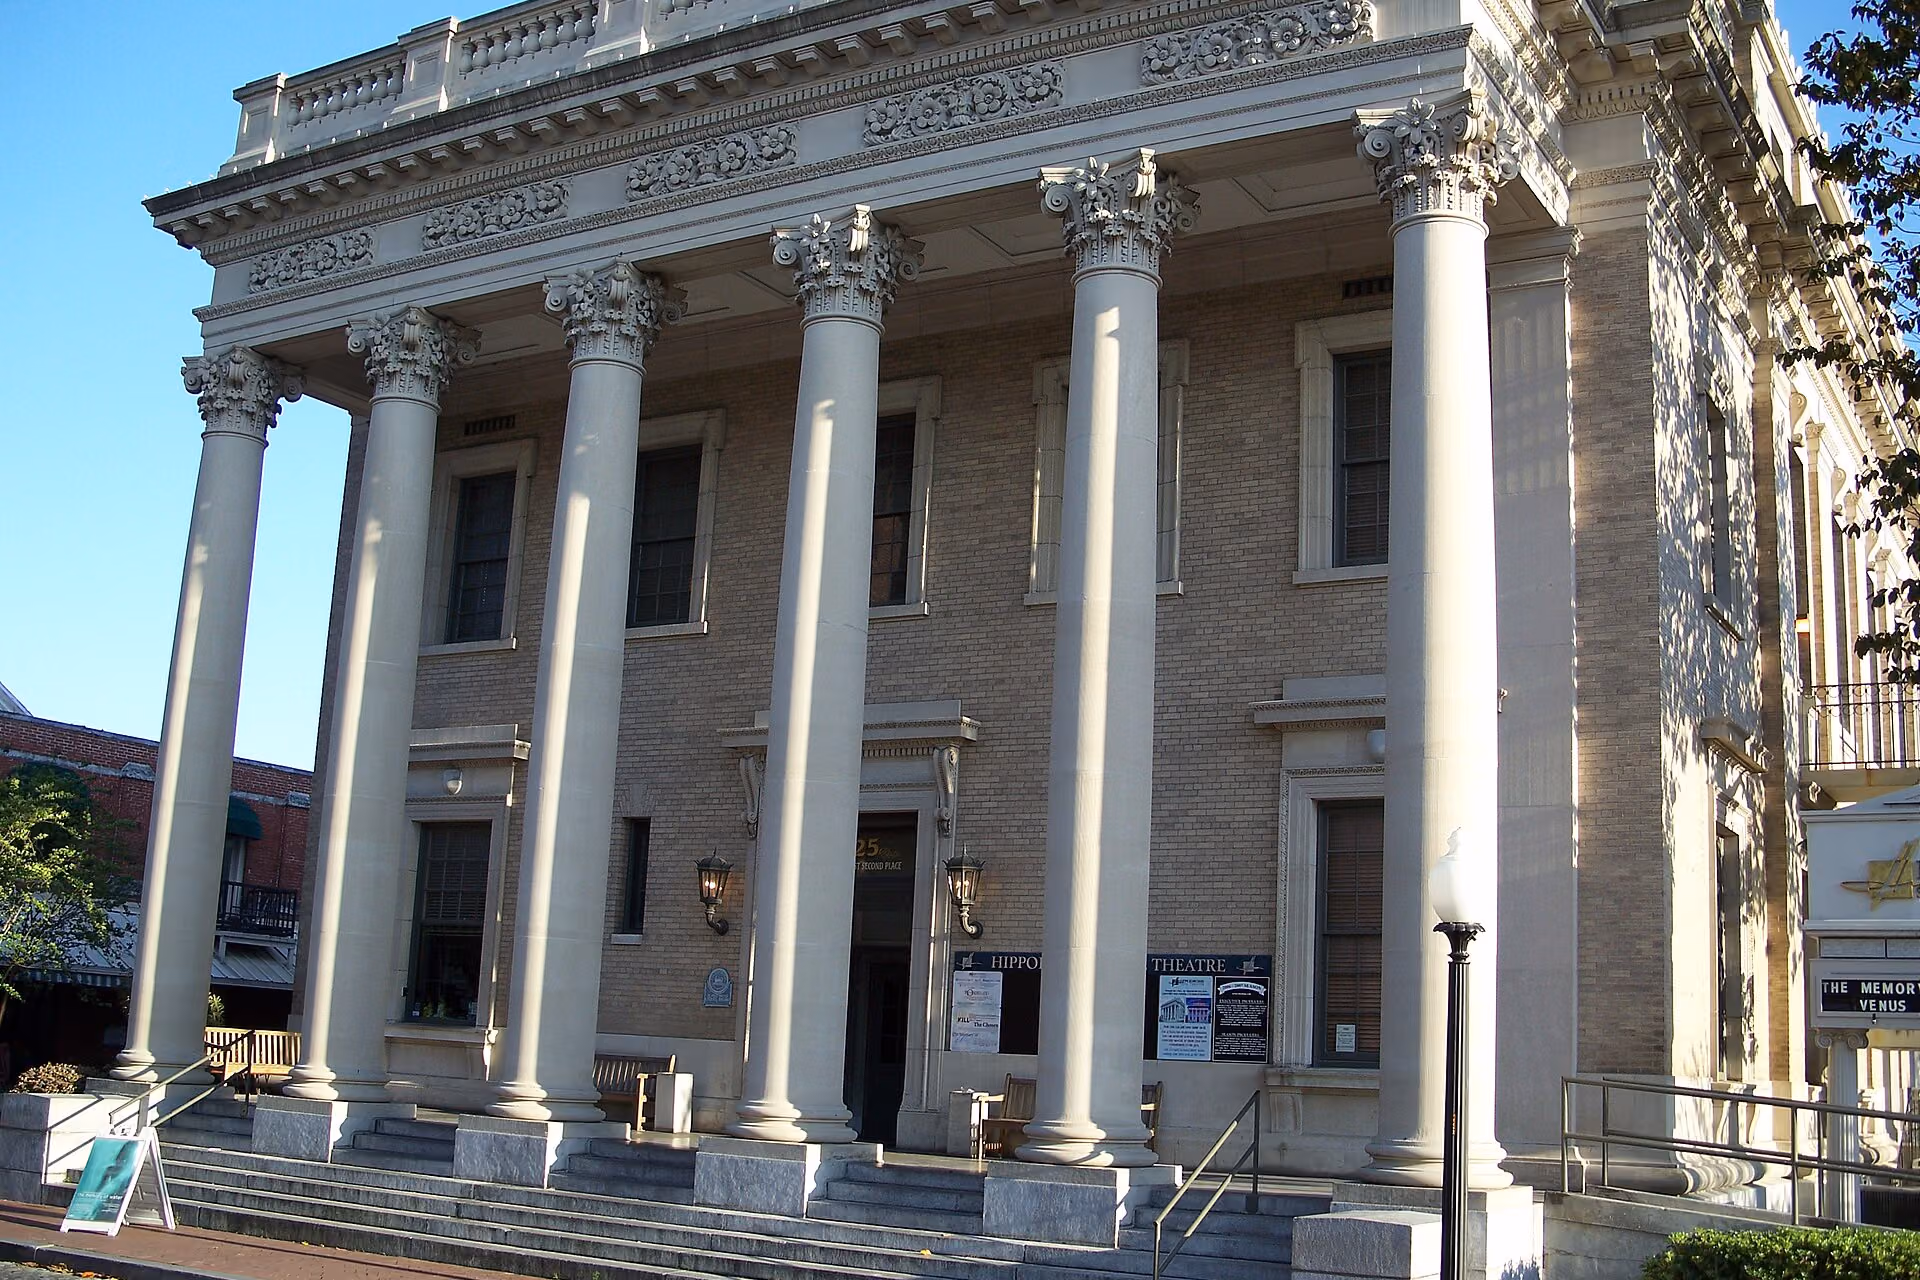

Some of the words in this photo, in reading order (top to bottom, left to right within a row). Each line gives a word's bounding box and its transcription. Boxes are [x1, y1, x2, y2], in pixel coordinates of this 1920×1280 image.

[861, 861, 884, 871] SECOND
[885, 861, 903, 871] PLACE
[1152, 958, 1226, 972] THEATRE
[1822, 981, 1848, 993] THE
[1859, 999, 1907, 1012] VENUS
